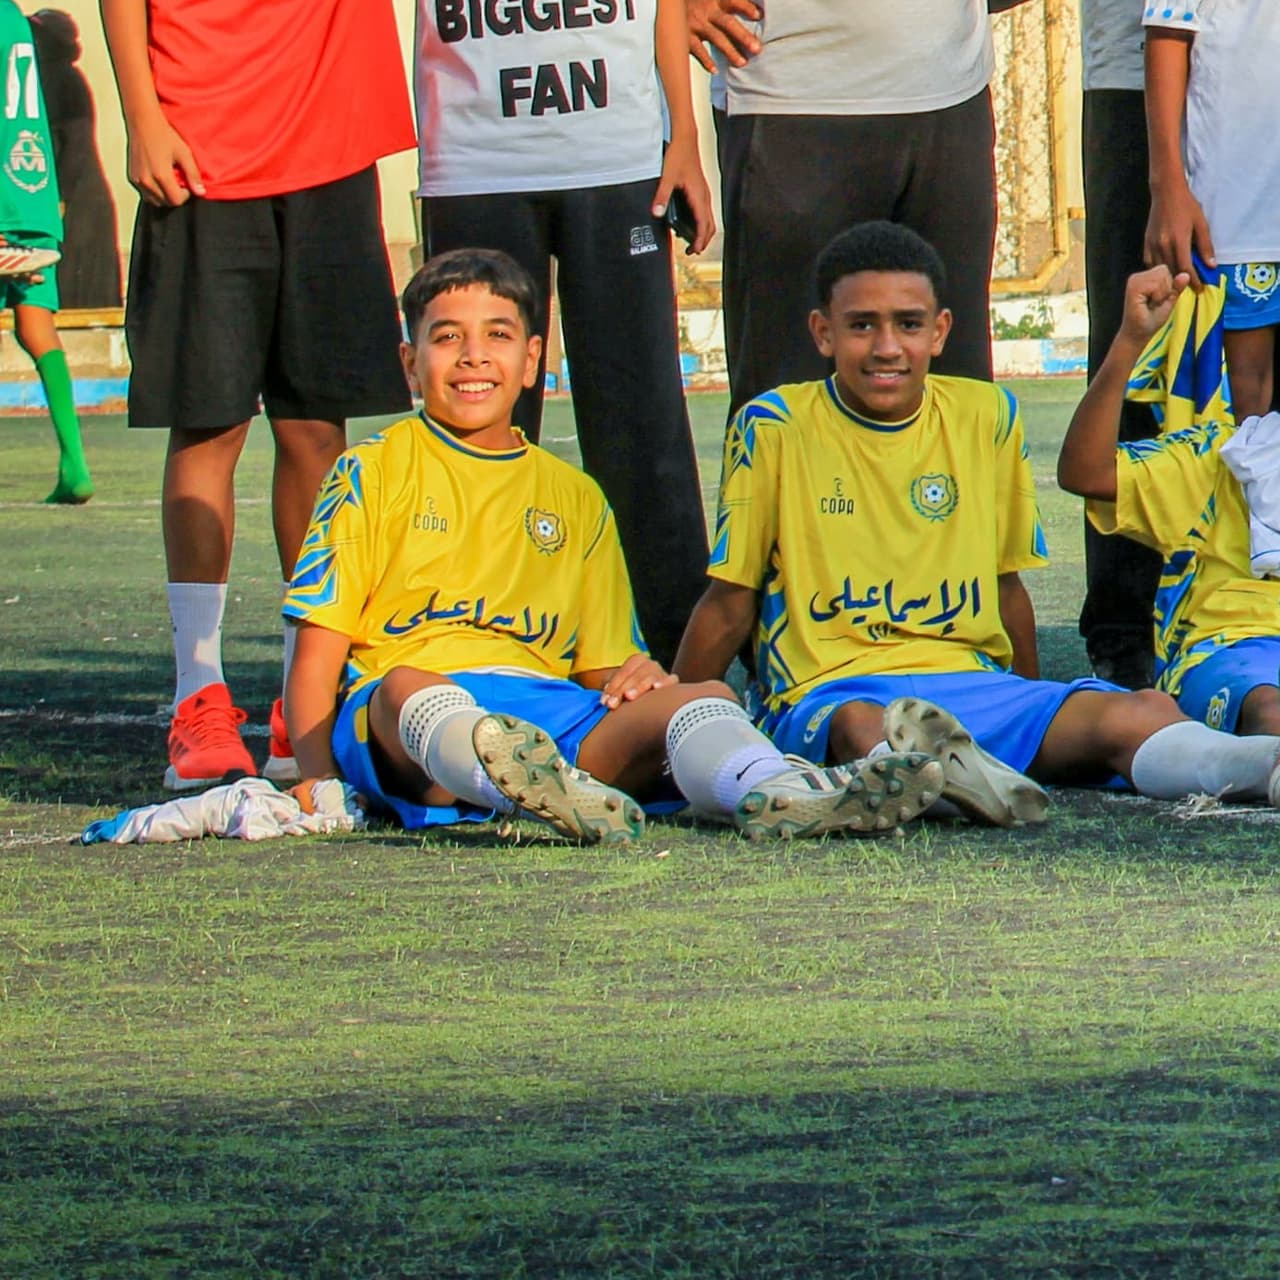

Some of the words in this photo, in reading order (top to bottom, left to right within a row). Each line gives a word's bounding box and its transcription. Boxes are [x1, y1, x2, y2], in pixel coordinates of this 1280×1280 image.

[499, 58, 608, 118] FAN
[821, 497, 855, 515] COPA
[414, 513, 449, 534] COPA
